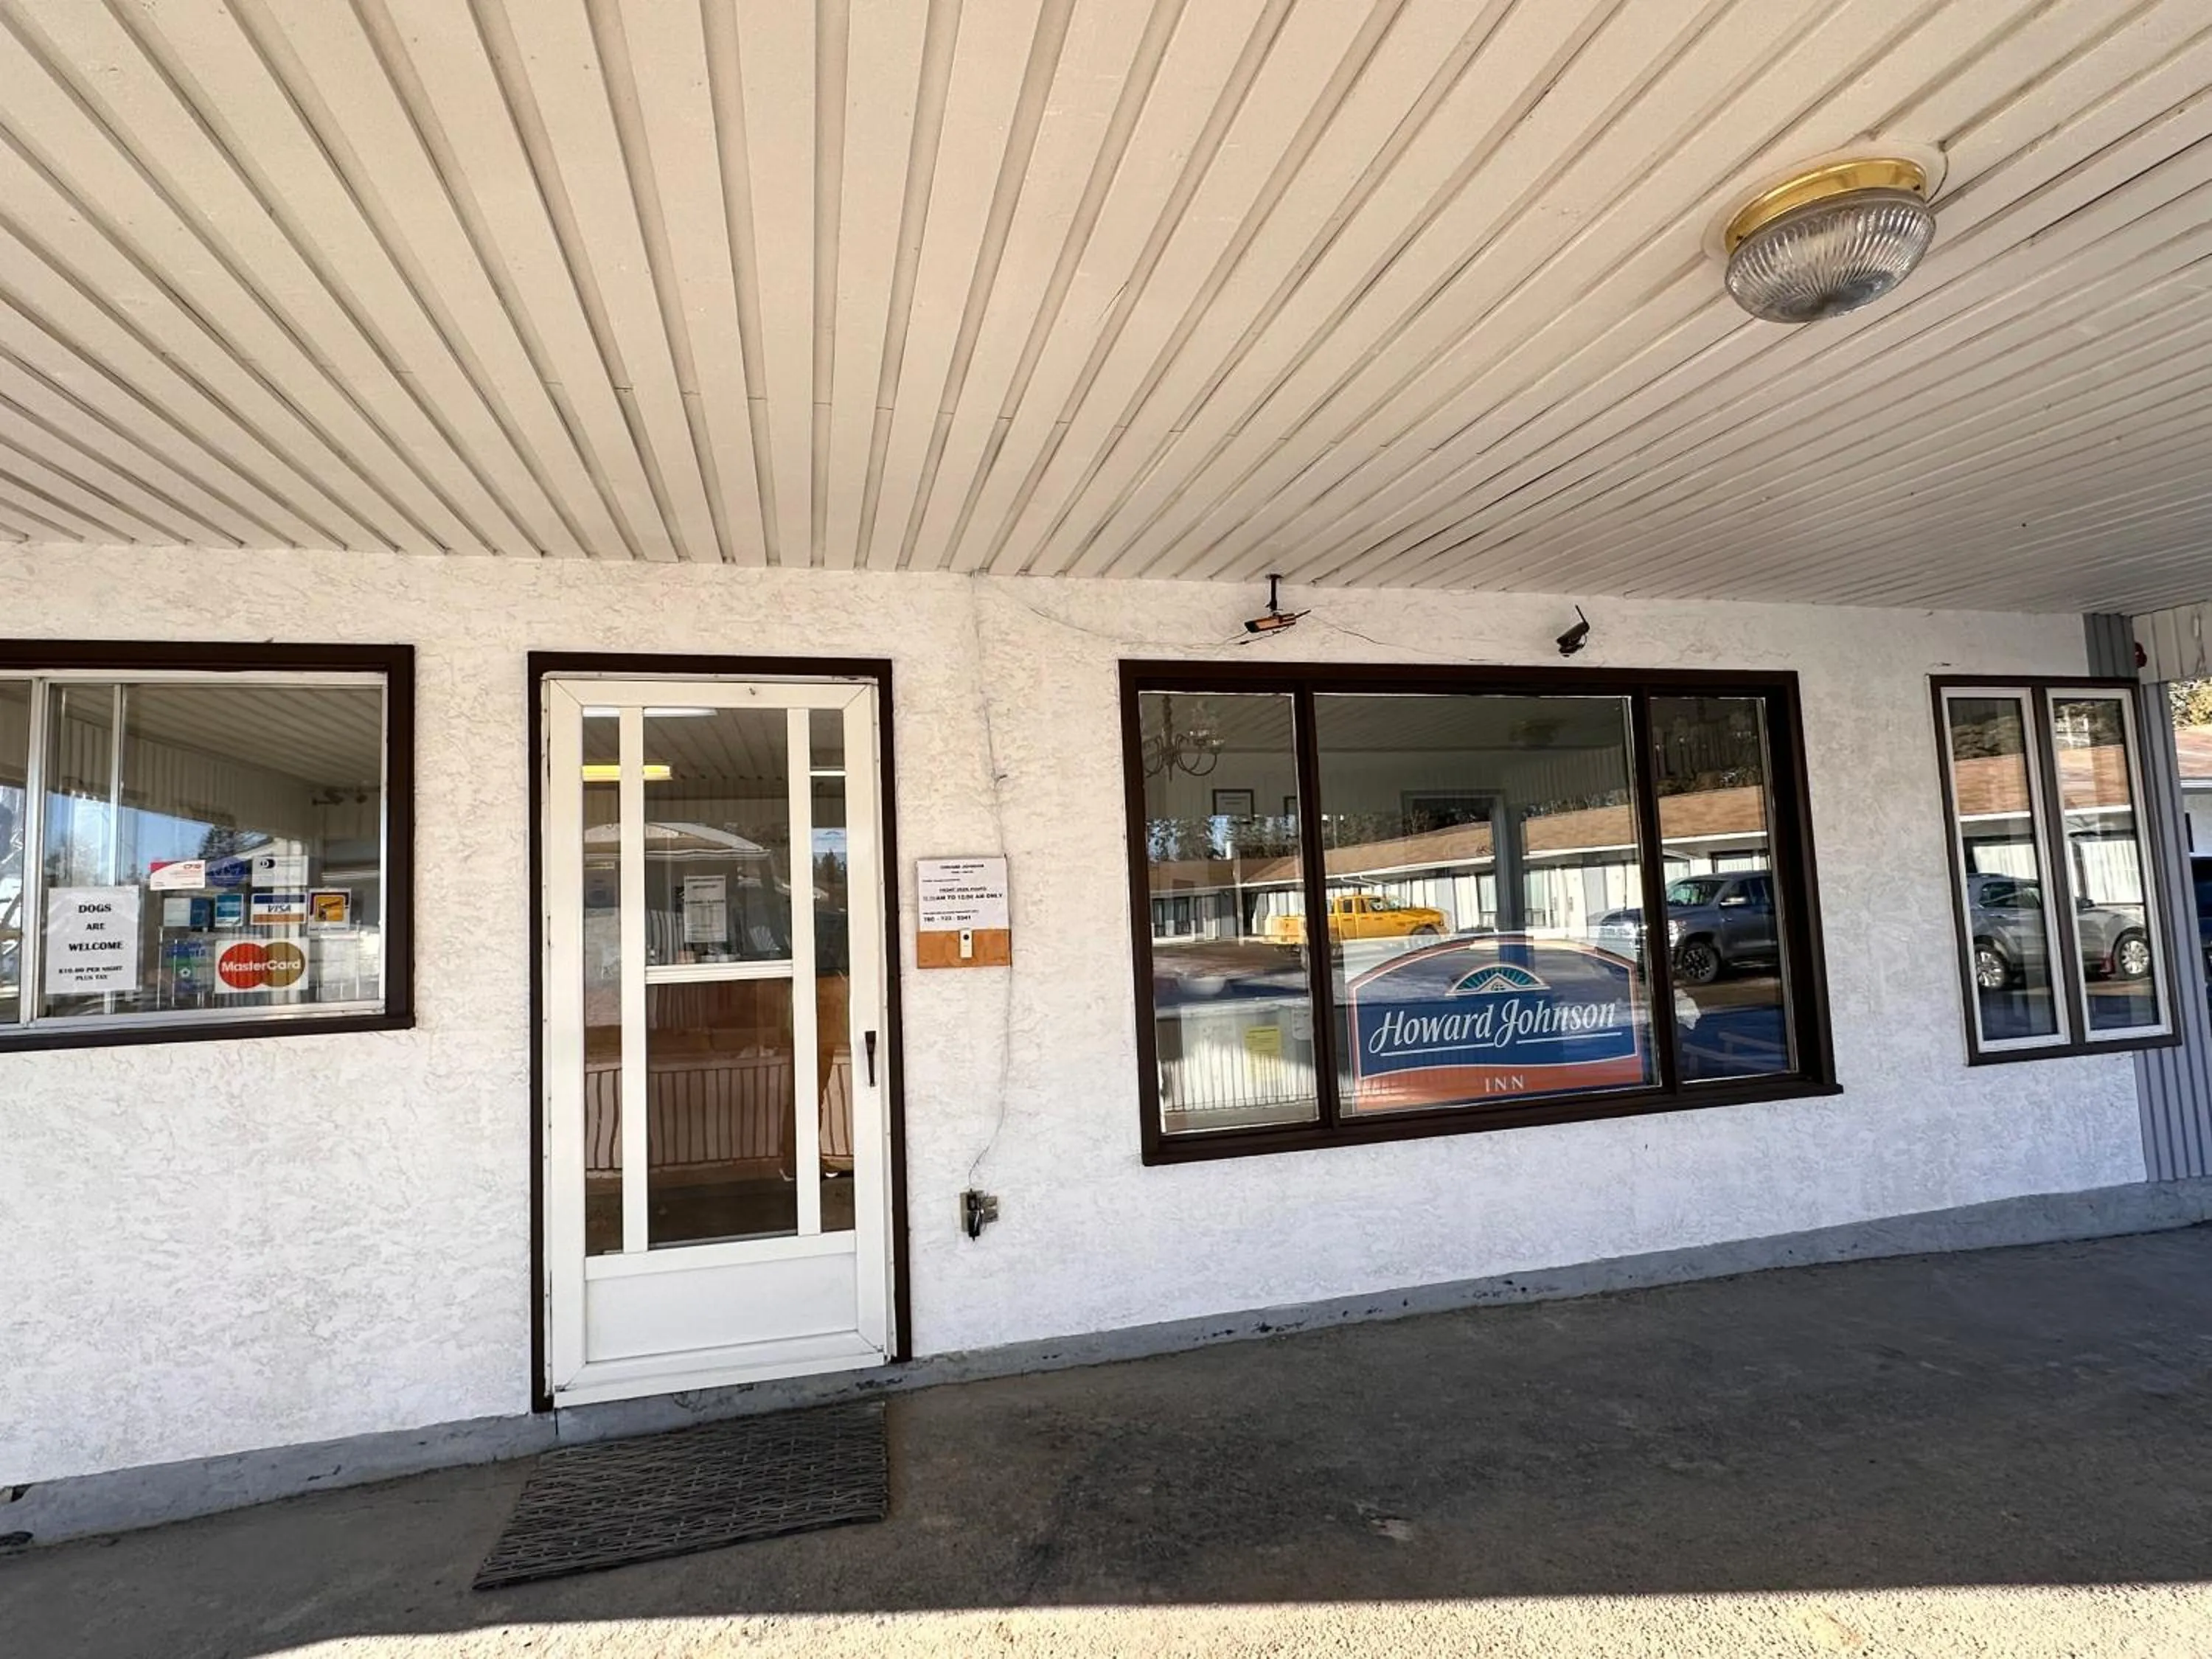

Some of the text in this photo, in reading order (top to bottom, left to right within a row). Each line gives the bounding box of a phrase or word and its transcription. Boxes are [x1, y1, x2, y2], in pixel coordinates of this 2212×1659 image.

[77, 903, 112, 914] DOGS
[267, 904, 291, 913] VISA
[86, 922, 106, 931] ARE
[68, 941, 124, 951] WELCOME
[221, 959, 302, 972] MasterCard
[1368, 998, 1615, 1054] Howard Johnson
[1484, 1074, 1526, 1093] INN
